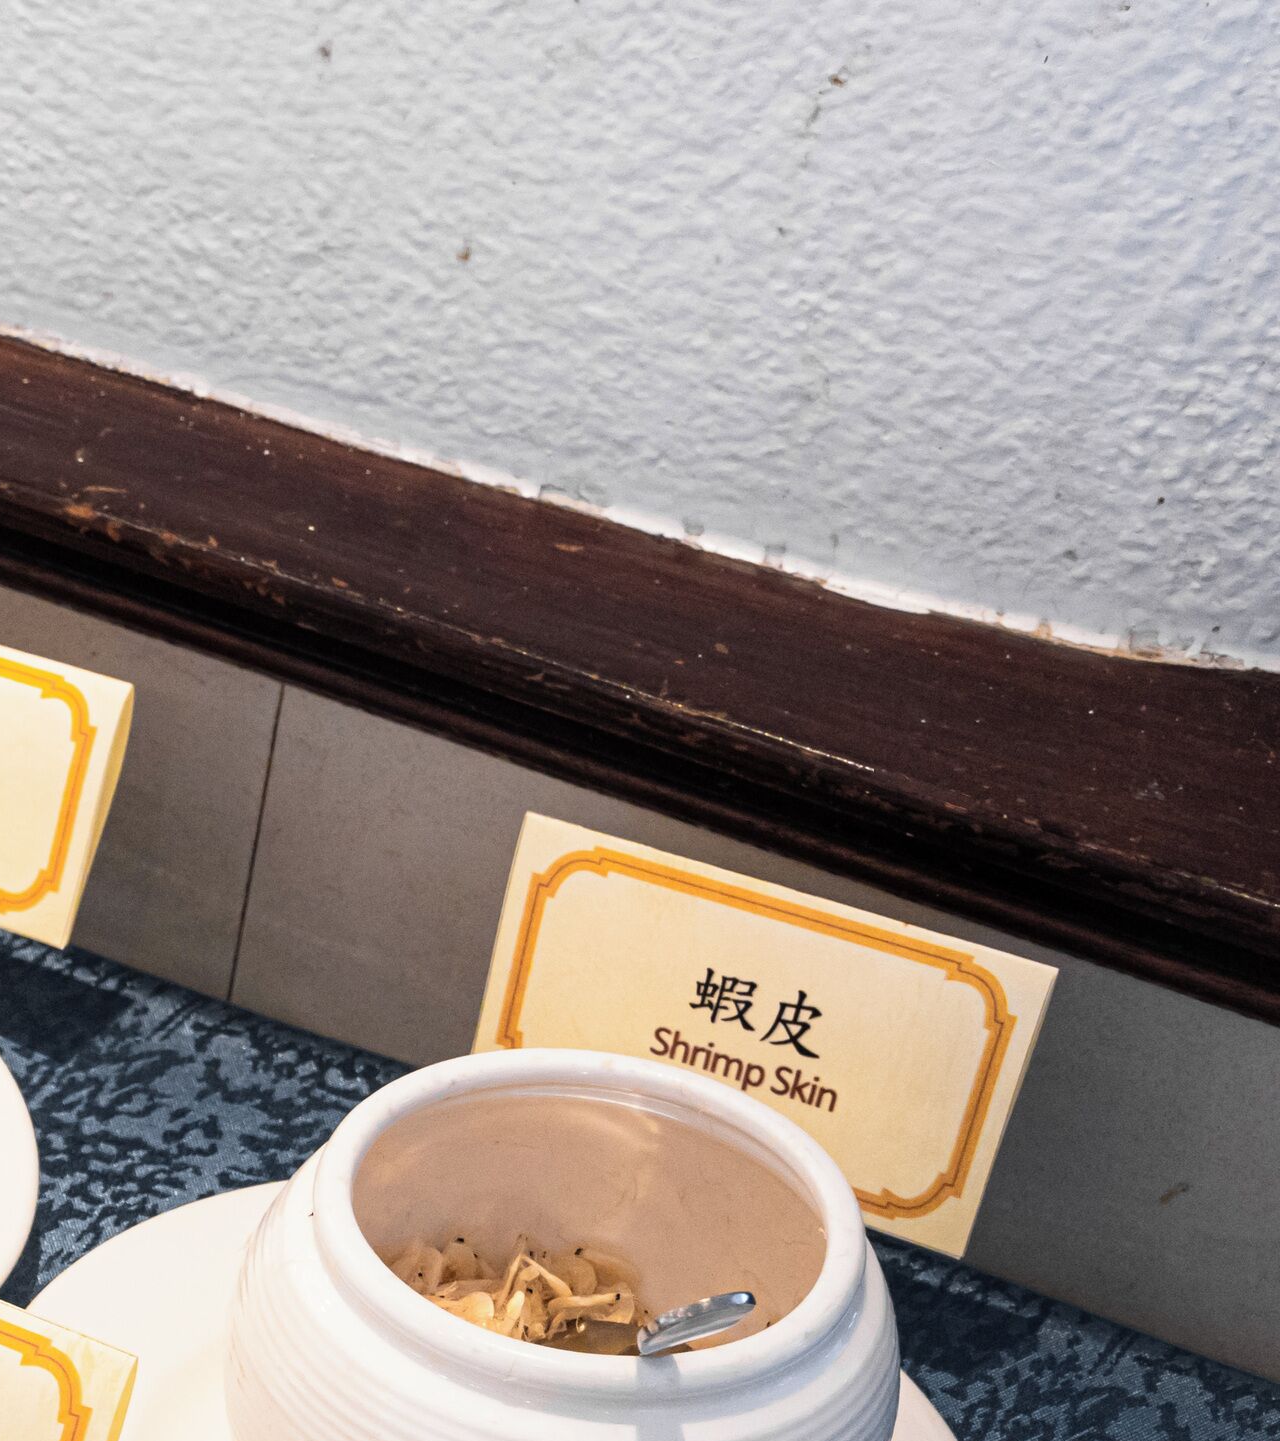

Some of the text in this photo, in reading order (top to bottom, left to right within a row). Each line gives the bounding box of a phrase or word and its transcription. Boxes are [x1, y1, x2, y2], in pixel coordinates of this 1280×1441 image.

[689, 967, 823, 1060] 蝦皮
[649, 1026, 838, 1113] Shrimp Skin
